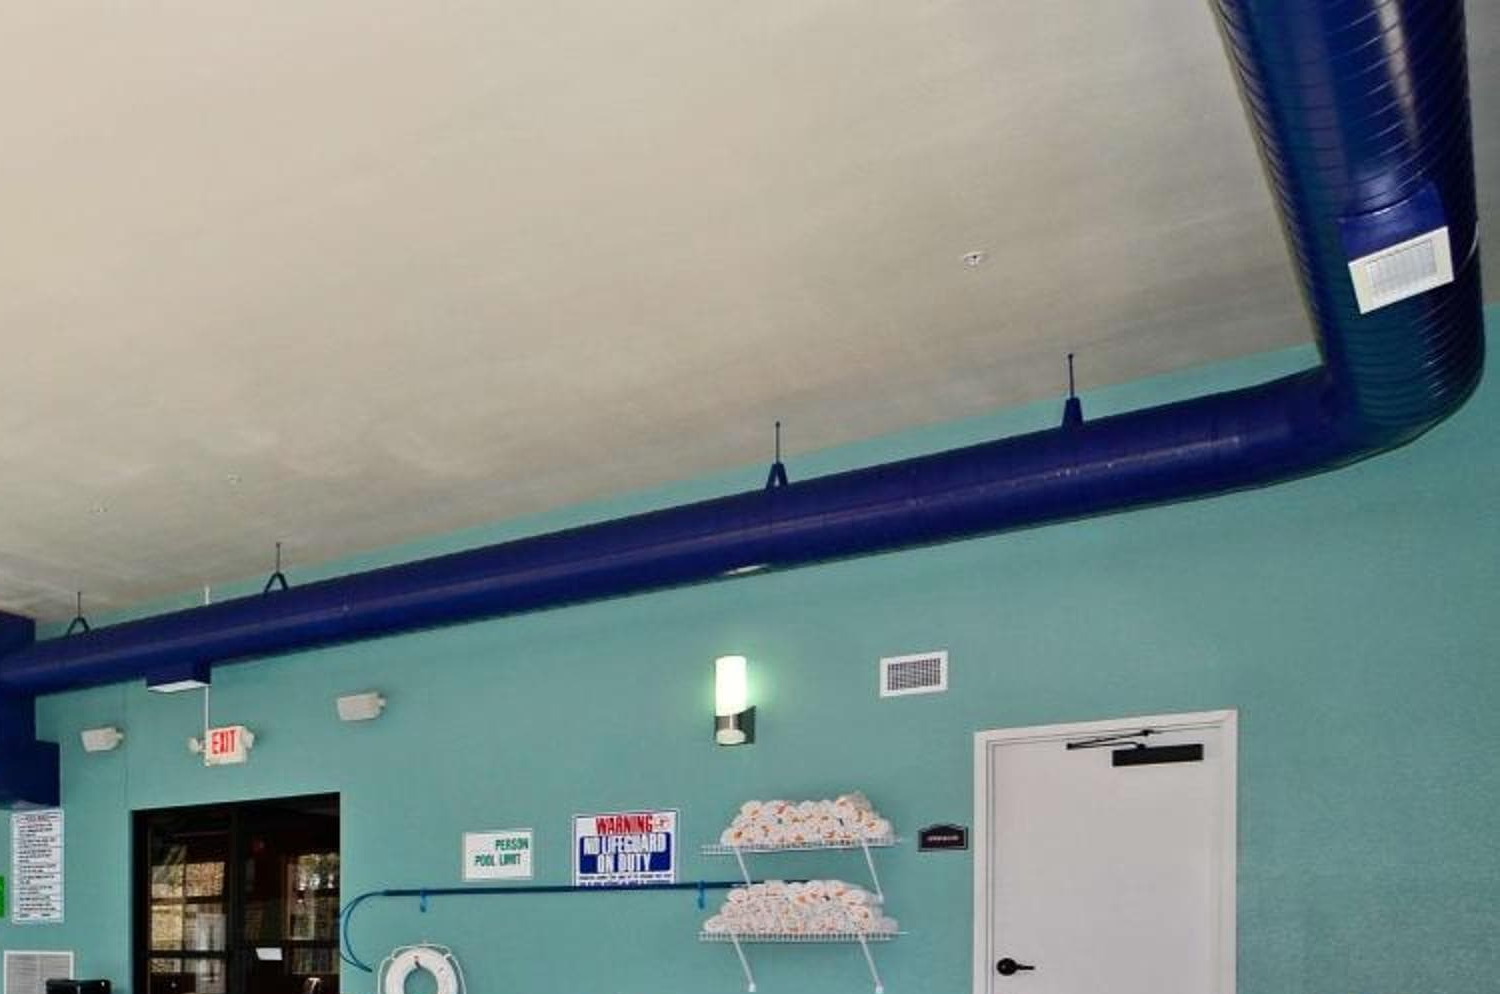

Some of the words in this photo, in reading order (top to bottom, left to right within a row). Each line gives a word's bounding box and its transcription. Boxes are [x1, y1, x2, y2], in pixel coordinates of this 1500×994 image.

[212, 730, 236, 754] EXIT
[595, 814, 653, 834] WARNING
[495, 837, 528, 850] PERSON
[583, 835, 601, 855] NO
[602, 832, 666, 854] LIFEGUARD
[475, 854, 495, 867] POOL
[499, 854, 521, 867] LIMIT
[597, 853, 614, 873] ON
[618, 851, 651, 872] DUTY
